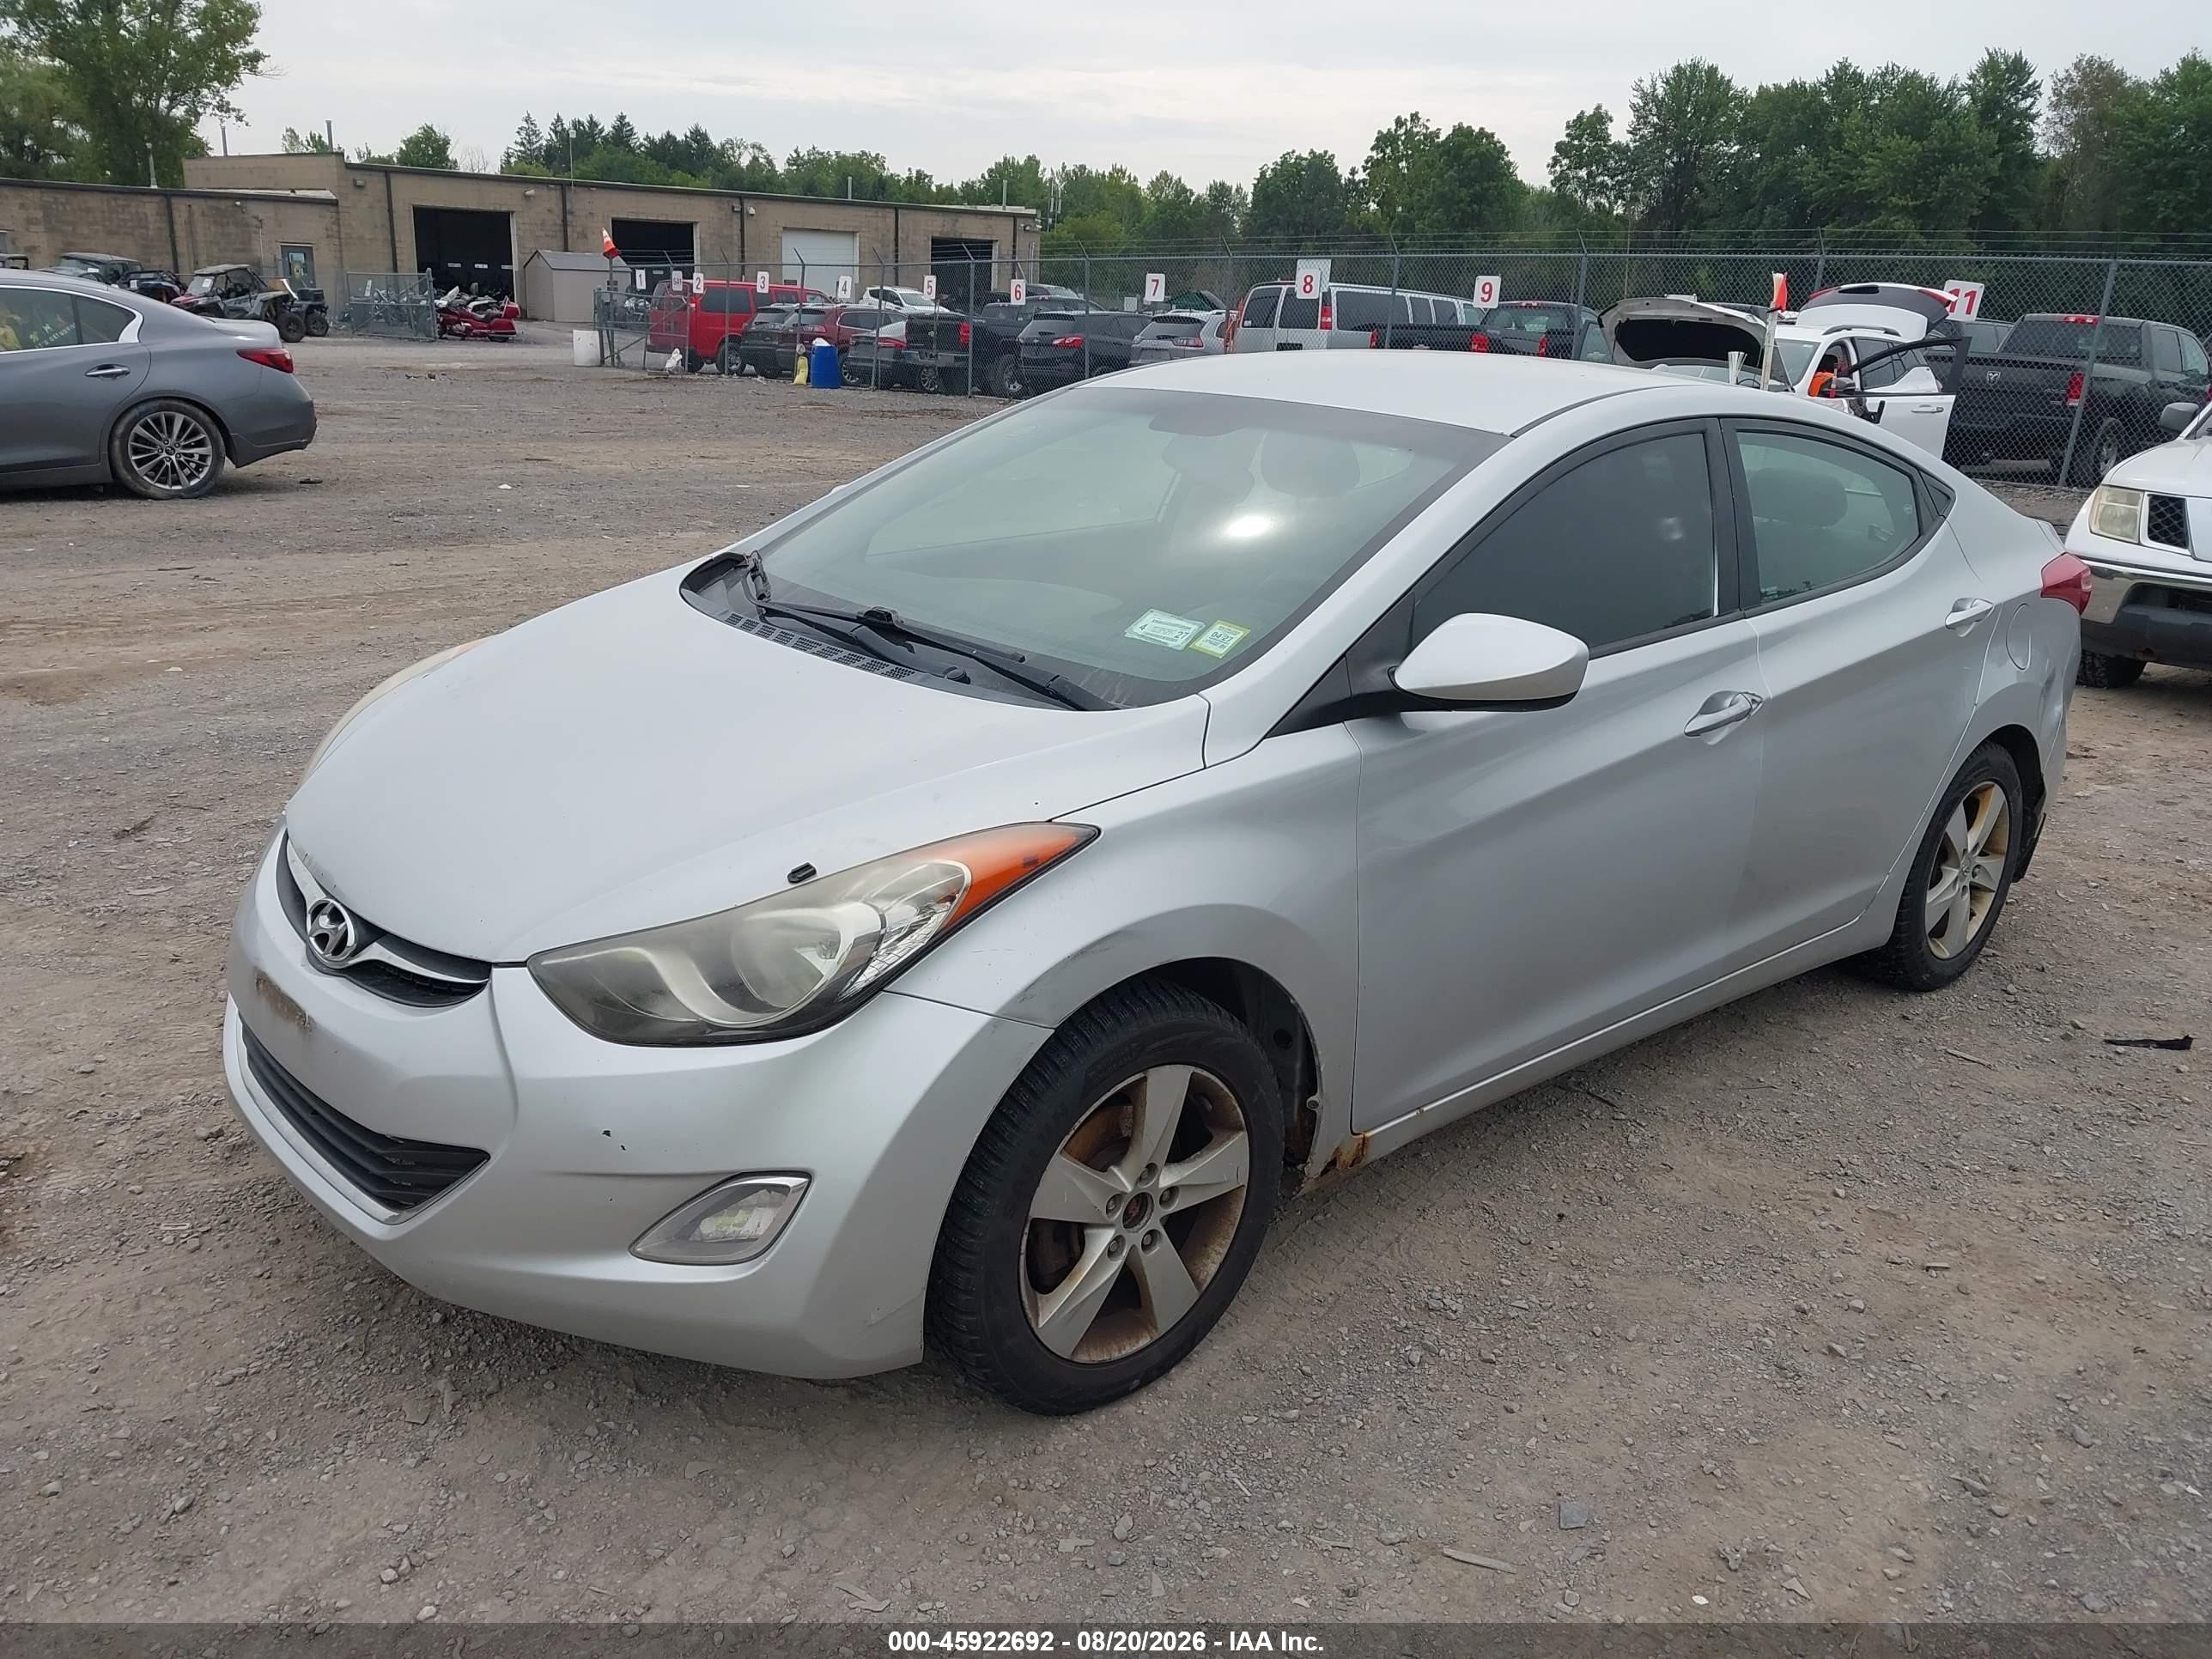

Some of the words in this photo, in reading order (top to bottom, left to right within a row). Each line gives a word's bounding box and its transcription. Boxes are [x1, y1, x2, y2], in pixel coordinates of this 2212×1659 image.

[638, 273, 643, 287] 1
[695, 276, 702, 290] 2
[759, 276, 766, 289] 3
[841, 280, 848, 295] 4
[927, 280, 933, 295] 5
[1151, 279, 1159, 296] 7
[1303, 274, 1314, 294] 8
[1014, 283, 1022, 301] 6
[1480, 282, 1493, 303] 9
[1948, 288, 1978, 315] 11
[1174, 631, 1189, 640] 27
